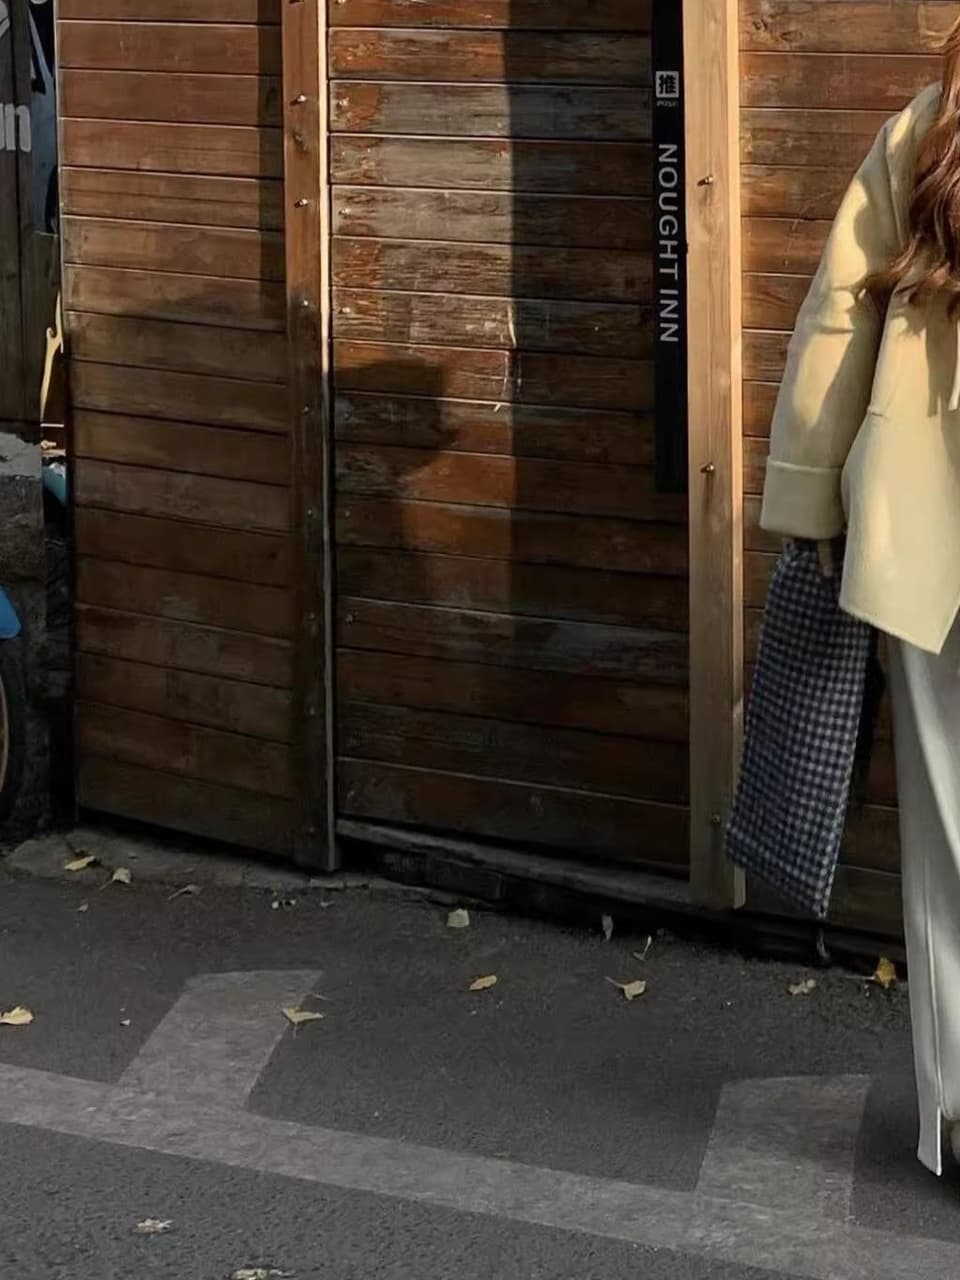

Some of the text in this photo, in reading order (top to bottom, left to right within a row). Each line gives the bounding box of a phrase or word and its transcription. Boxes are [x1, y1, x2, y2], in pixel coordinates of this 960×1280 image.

[658, 73, 677, 95] 推
[658, 144, 679, 341] NOUGHT INN
